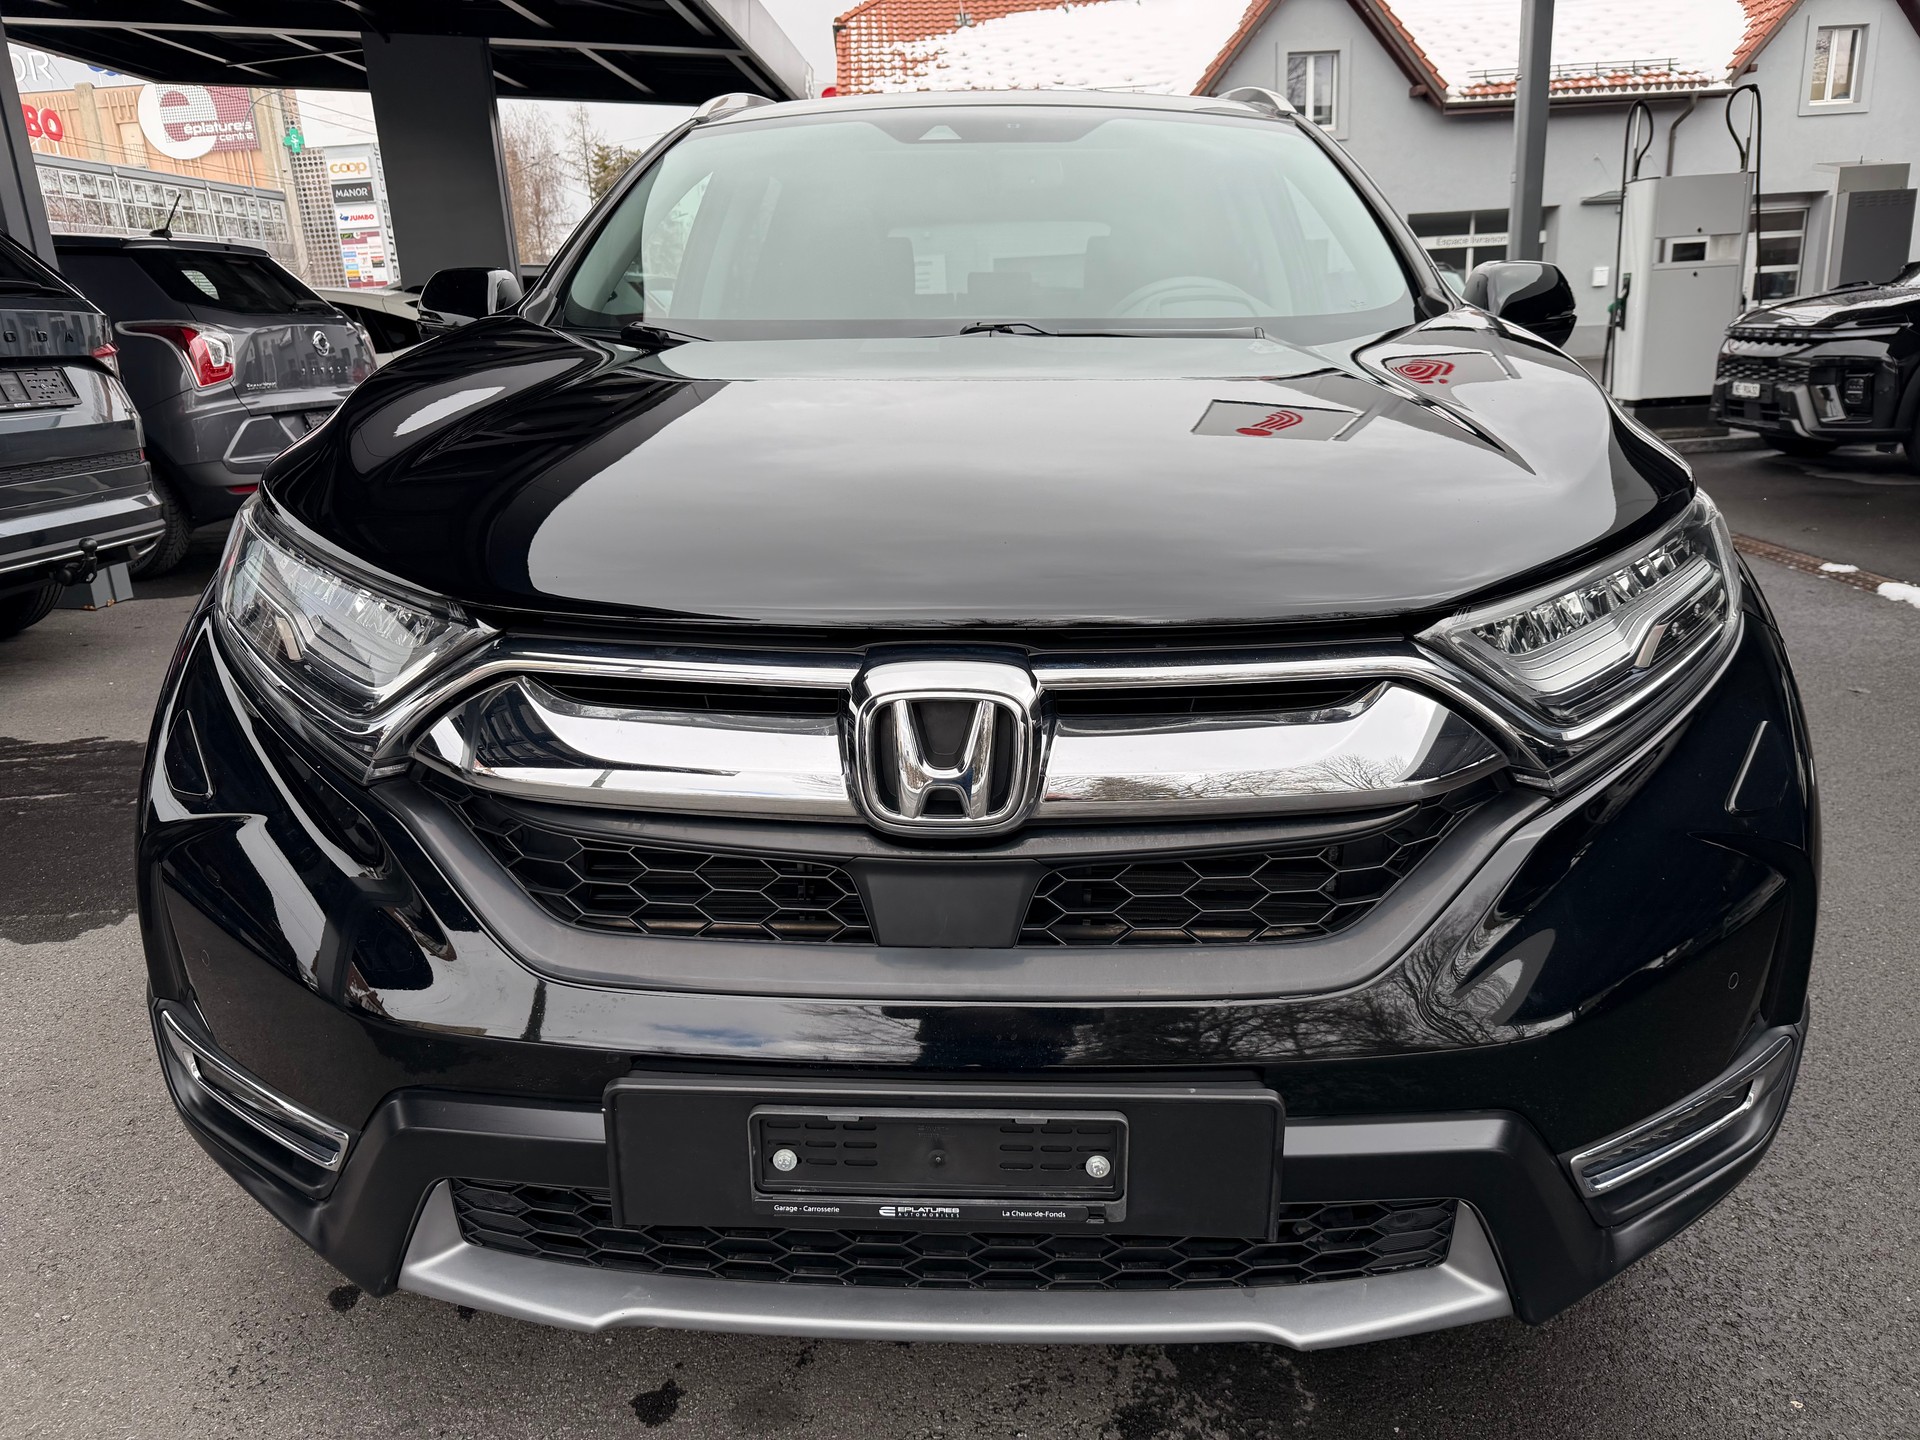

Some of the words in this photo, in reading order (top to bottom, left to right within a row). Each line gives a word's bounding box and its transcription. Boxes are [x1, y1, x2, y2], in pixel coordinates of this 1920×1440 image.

[183, 121, 252, 136] éplatures
[219, 132, 254, 141] centre
[329, 162, 367, 175] coop
[335, 187, 369, 198] MANOR
[349, 214, 375, 222] JUMBO
[773, 1204, 798, 1214] Garage
[803, 1205, 840, 1213] Carrosserie
[1001, 1209, 1009, 1217] La
[1011, 1209, 1066, 1218] Chaux-de-Fonds
